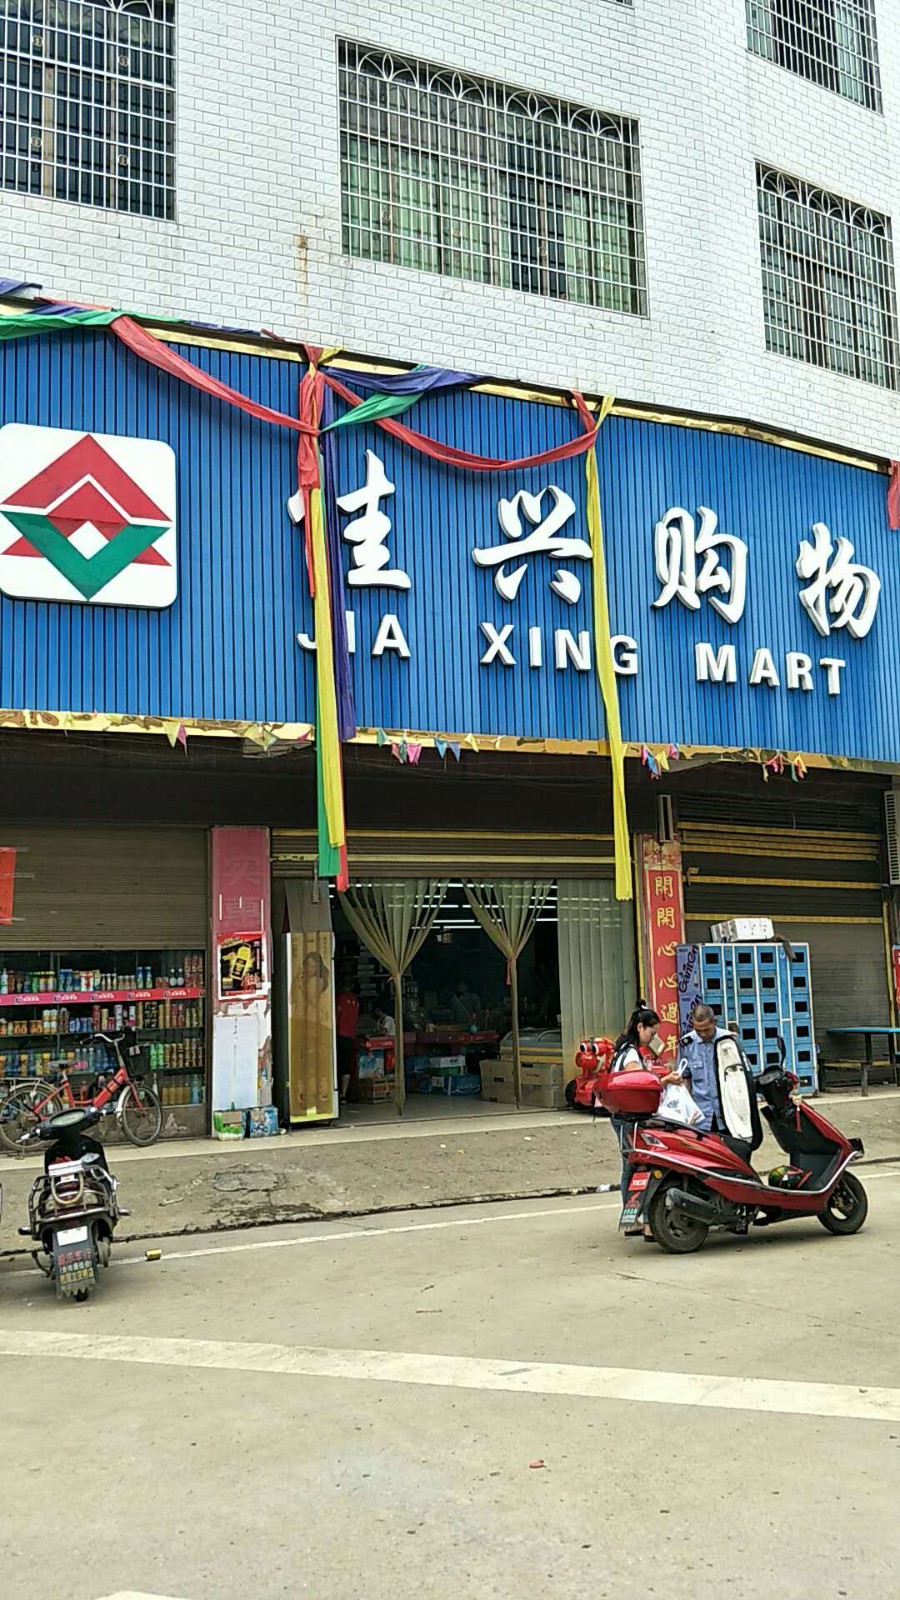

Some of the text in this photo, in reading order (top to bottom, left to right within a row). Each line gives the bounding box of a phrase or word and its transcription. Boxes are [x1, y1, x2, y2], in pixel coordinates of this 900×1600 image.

[287, 449, 881, 639] 佳兴购物
[479, 621, 639, 676] XING
[694, 642, 846, 697] MART
